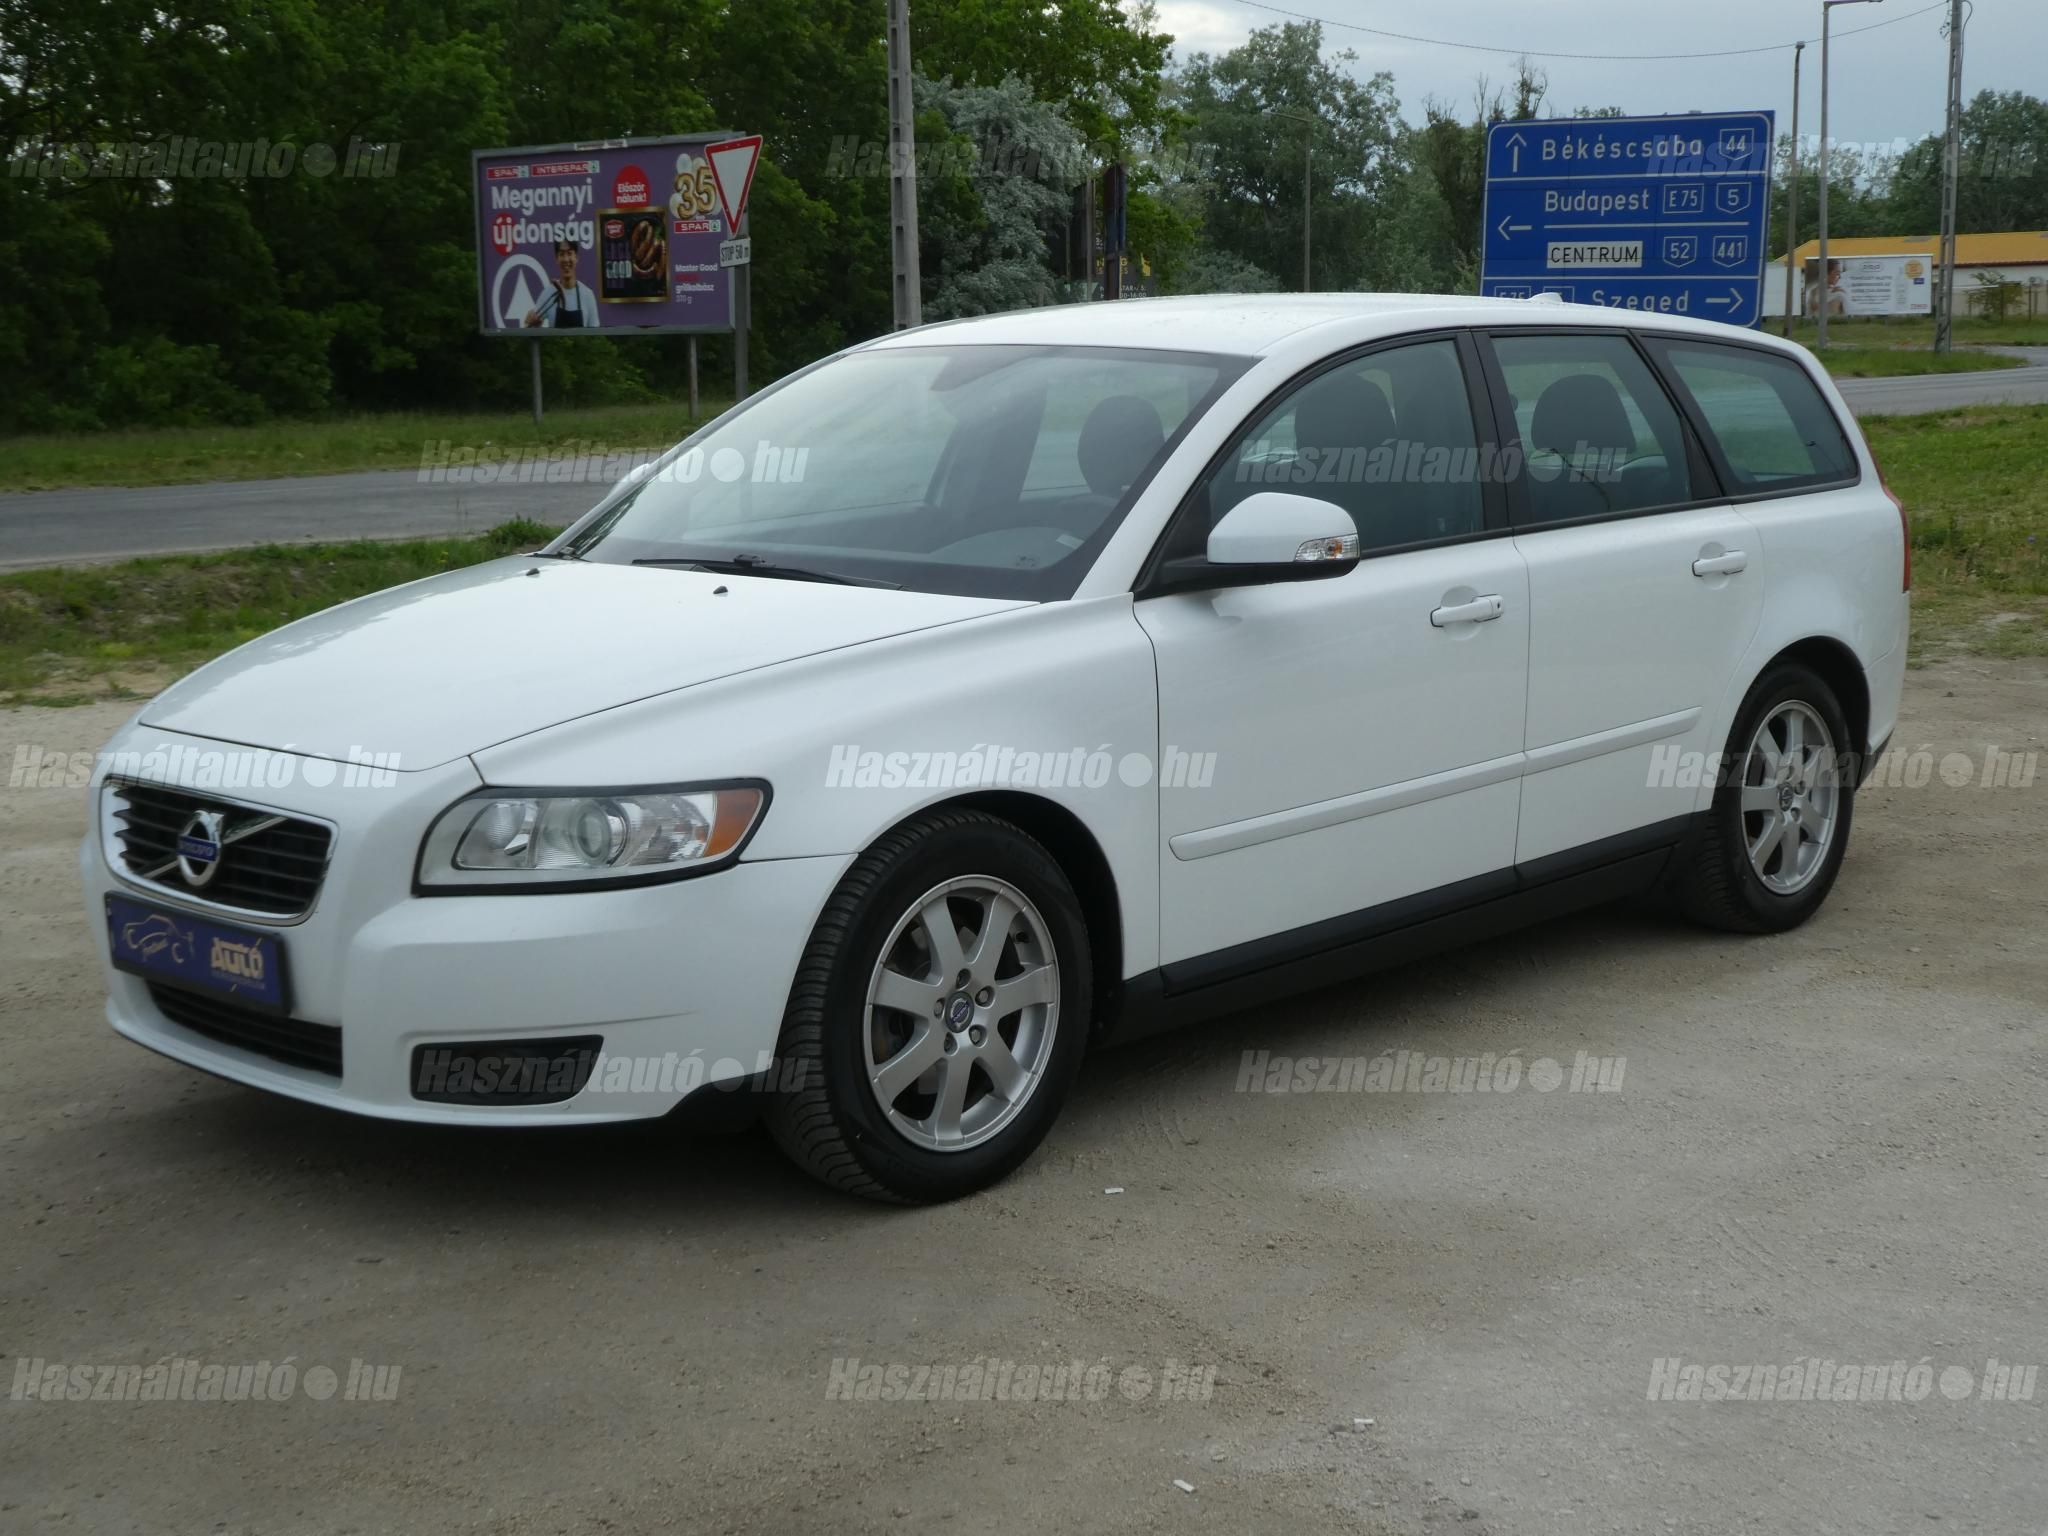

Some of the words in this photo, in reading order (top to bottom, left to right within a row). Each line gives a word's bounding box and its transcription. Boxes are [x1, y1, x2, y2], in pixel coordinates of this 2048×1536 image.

[1542, 135, 1702, 161] Békéscsaba
[1727, 135, 1746, 152] 44
[494, 167, 519, 177] SPAR
[536, 163, 589, 174] INTERSPAR
[491, 177, 593, 216] Megannyi
[675, 167, 718, 219] 35
[1544, 189, 1649, 216] Budapest
[1727, 189, 1740, 205] 5
[493, 213, 595, 253] újdonság
[680, 222, 709, 231] SPAR
[1551, 246, 1638, 263] CENTRUM
[1670, 242, 1690, 258] 52
[1717, 242, 1743, 258] 441
[699, 263, 718, 272] Good
[1592, 289, 1689, 314] Szeged
